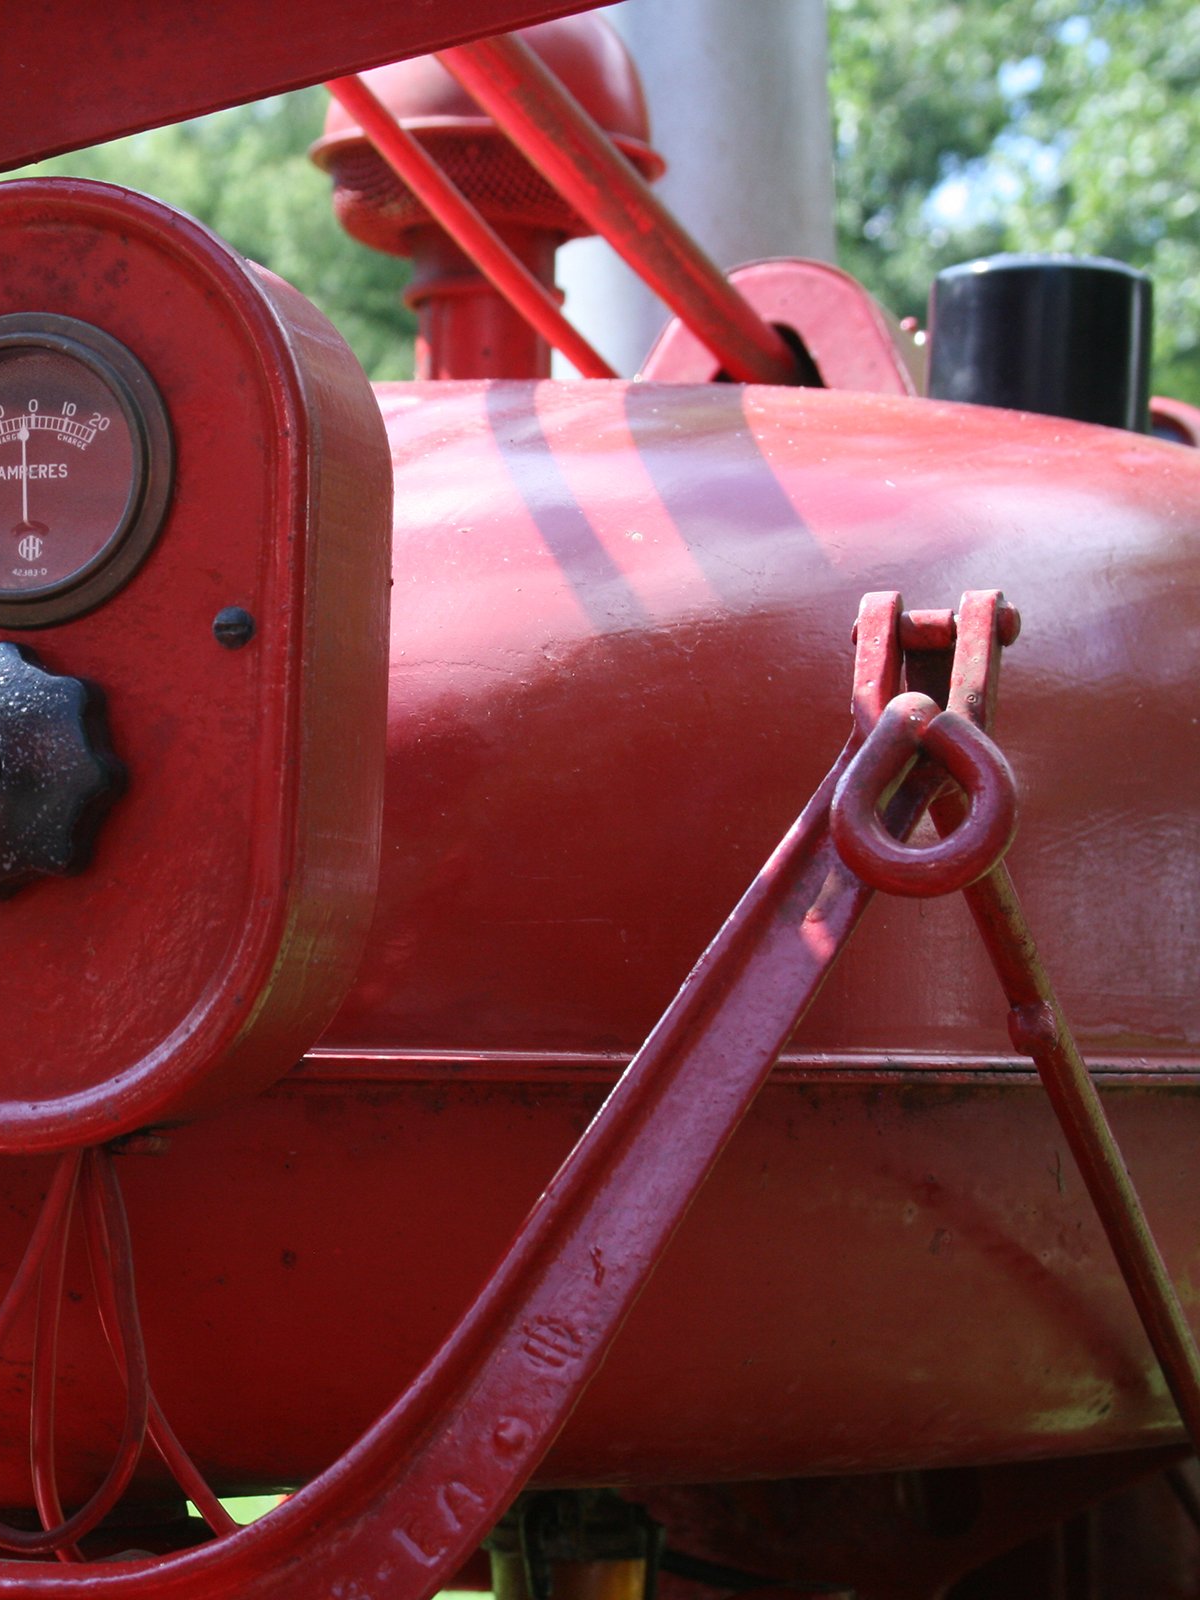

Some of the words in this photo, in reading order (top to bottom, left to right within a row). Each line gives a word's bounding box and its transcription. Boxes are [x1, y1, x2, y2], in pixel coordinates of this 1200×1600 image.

[28, 399, 39, 413] 0
[62, 401, 77, 416] 10
[89, 413, 111, 432] 20
[57, 433, 88, 451] CHARGE
